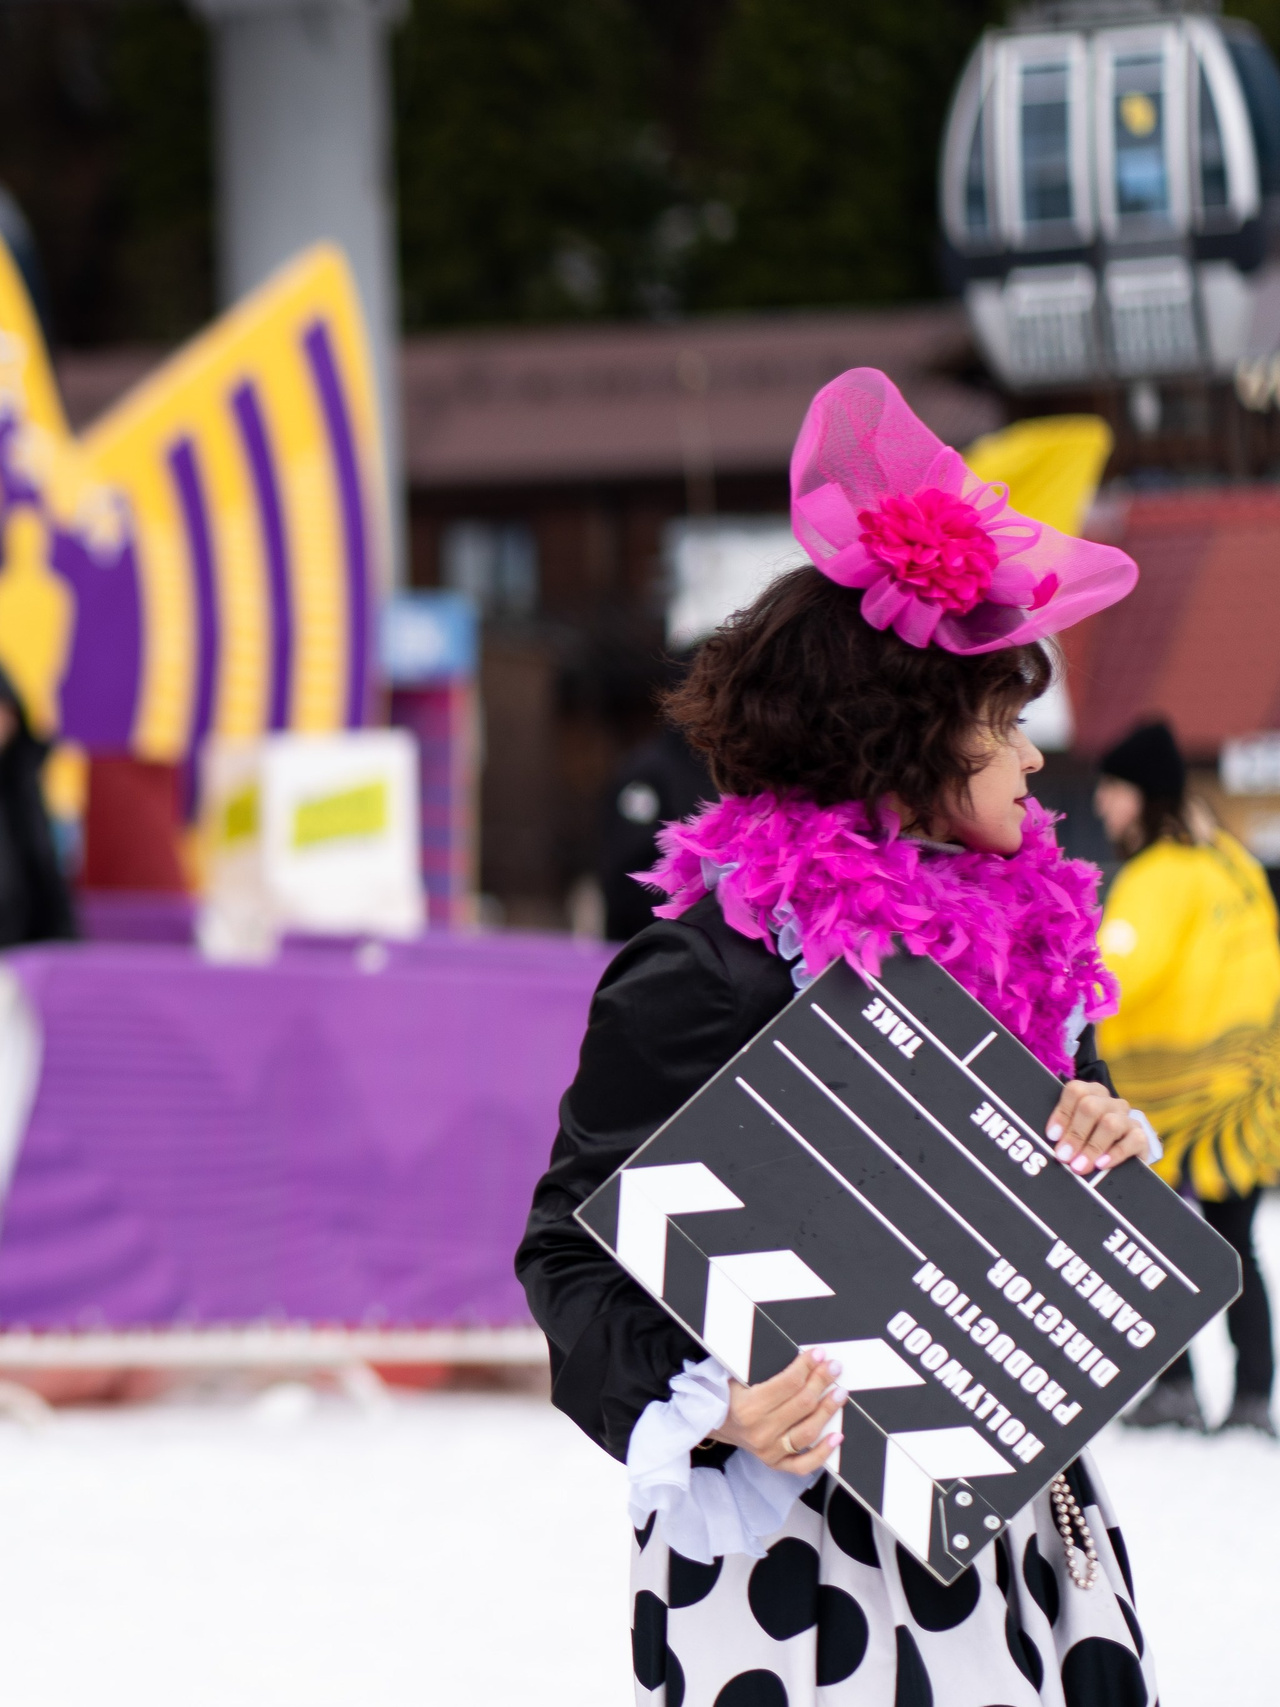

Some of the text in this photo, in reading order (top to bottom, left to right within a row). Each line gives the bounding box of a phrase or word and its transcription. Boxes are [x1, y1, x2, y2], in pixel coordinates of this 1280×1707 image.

[860, 996, 923, 1059] TAKE
[969, 1100, 1048, 1176] SCENE
[1044, 1238, 1156, 1348] CAMERA
[1101, 1227, 1167, 1290] DATE
[911, 1260, 1083, 1425] PRODUCTION
[985, 1256, 1120, 1388] DIRECTOR
[885, 1310, 1045, 1463] HOLLYWOOD
